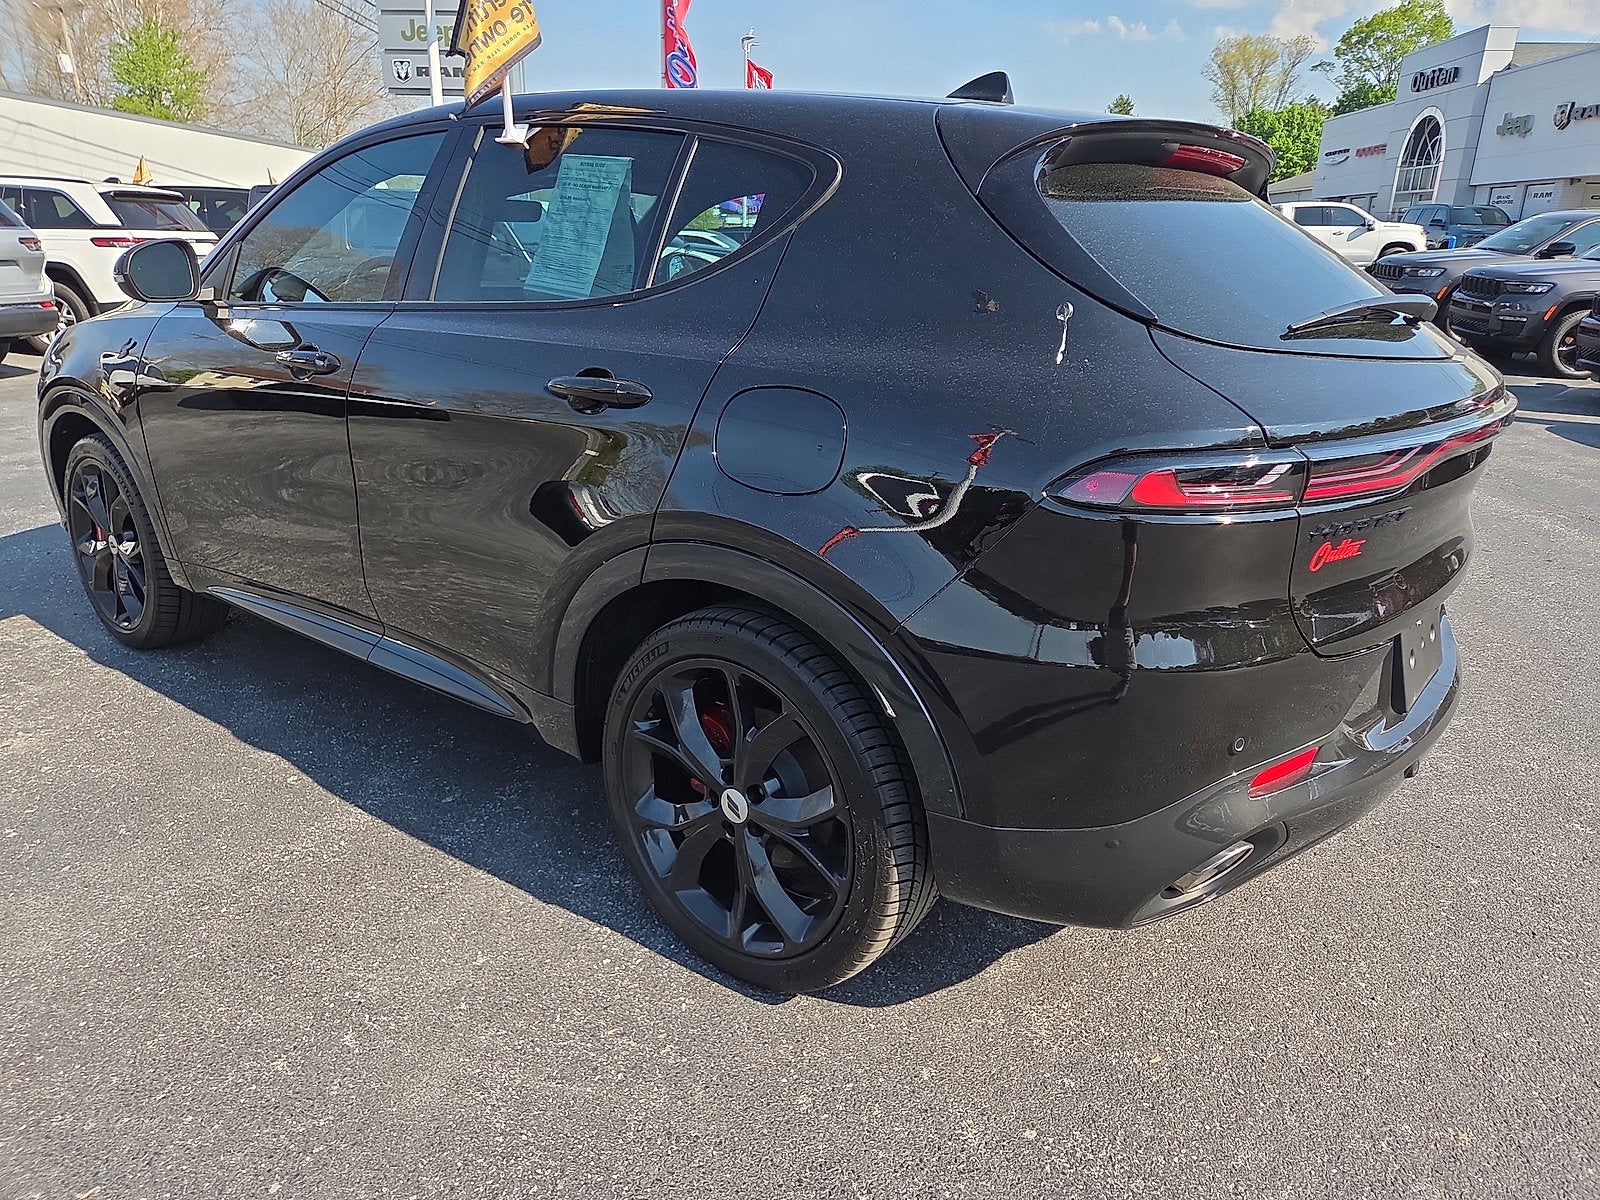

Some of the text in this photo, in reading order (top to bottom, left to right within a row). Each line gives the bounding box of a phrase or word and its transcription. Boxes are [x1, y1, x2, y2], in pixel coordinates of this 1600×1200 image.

[1571, 104, 1600, 120] RA
[1496, 112, 1535, 139] Jeep
[1533, 191, 1553, 199] RAM
